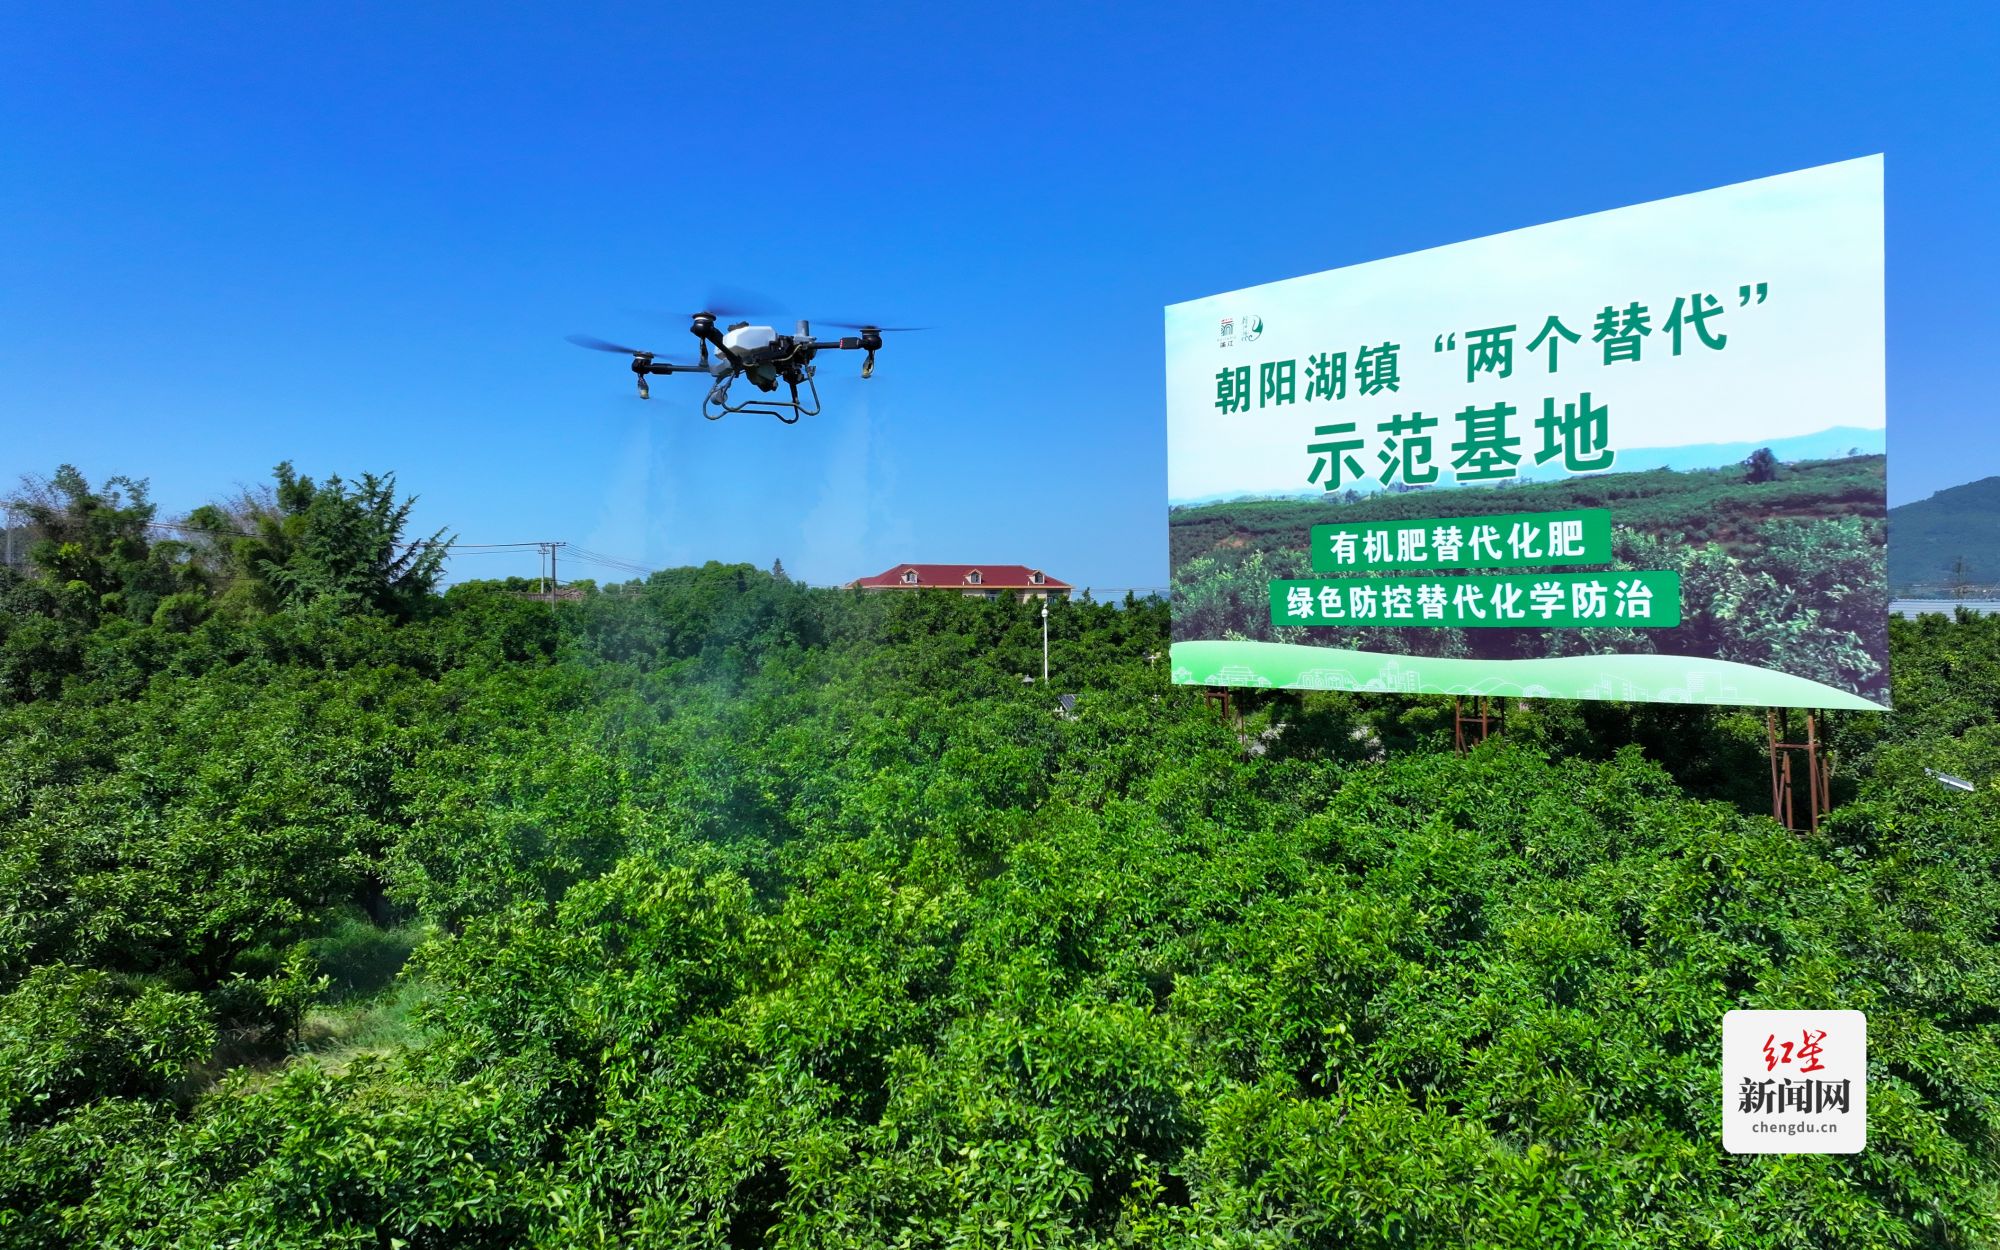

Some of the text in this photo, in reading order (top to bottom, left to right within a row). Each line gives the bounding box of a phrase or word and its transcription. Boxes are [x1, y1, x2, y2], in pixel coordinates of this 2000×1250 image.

[1306, 393, 1615, 491] 示范基地
[1329, 520, 1585, 565] 有机肥替代化肥
[1286, 580, 1654, 620] 绿色防控替代化学防治
